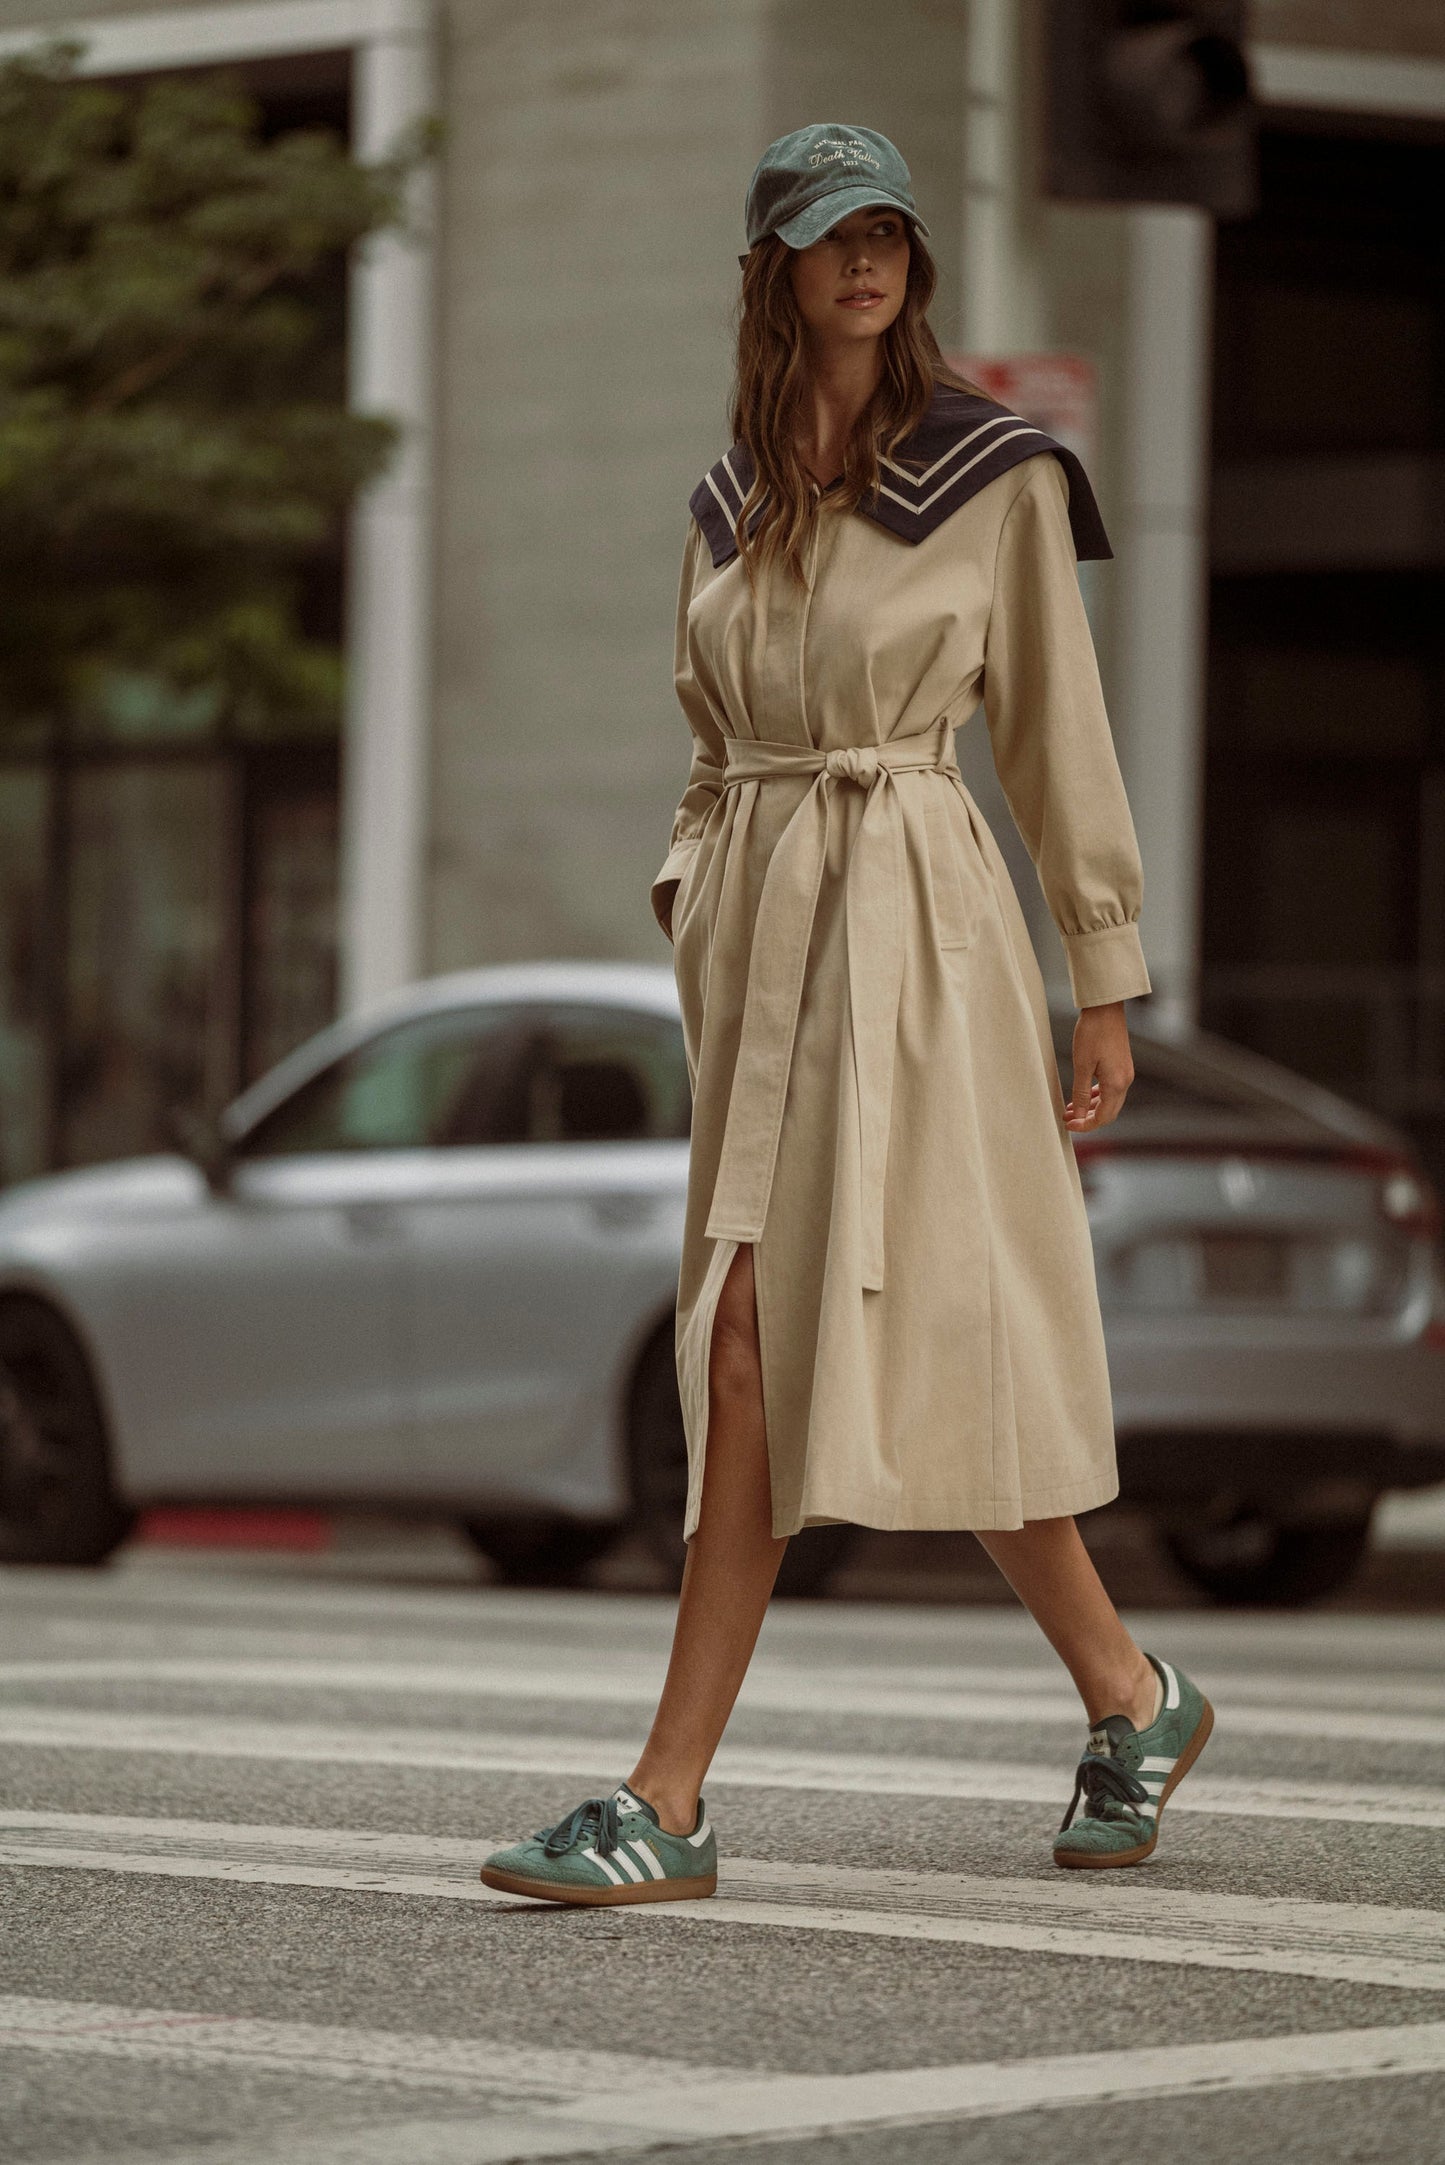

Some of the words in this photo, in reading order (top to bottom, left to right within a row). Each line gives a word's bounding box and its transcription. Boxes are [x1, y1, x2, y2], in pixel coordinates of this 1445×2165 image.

[814, 139, 847, 149] NATAL
[809, 149, 845, 169] Death
[847, 148, 880, 170] Valley
